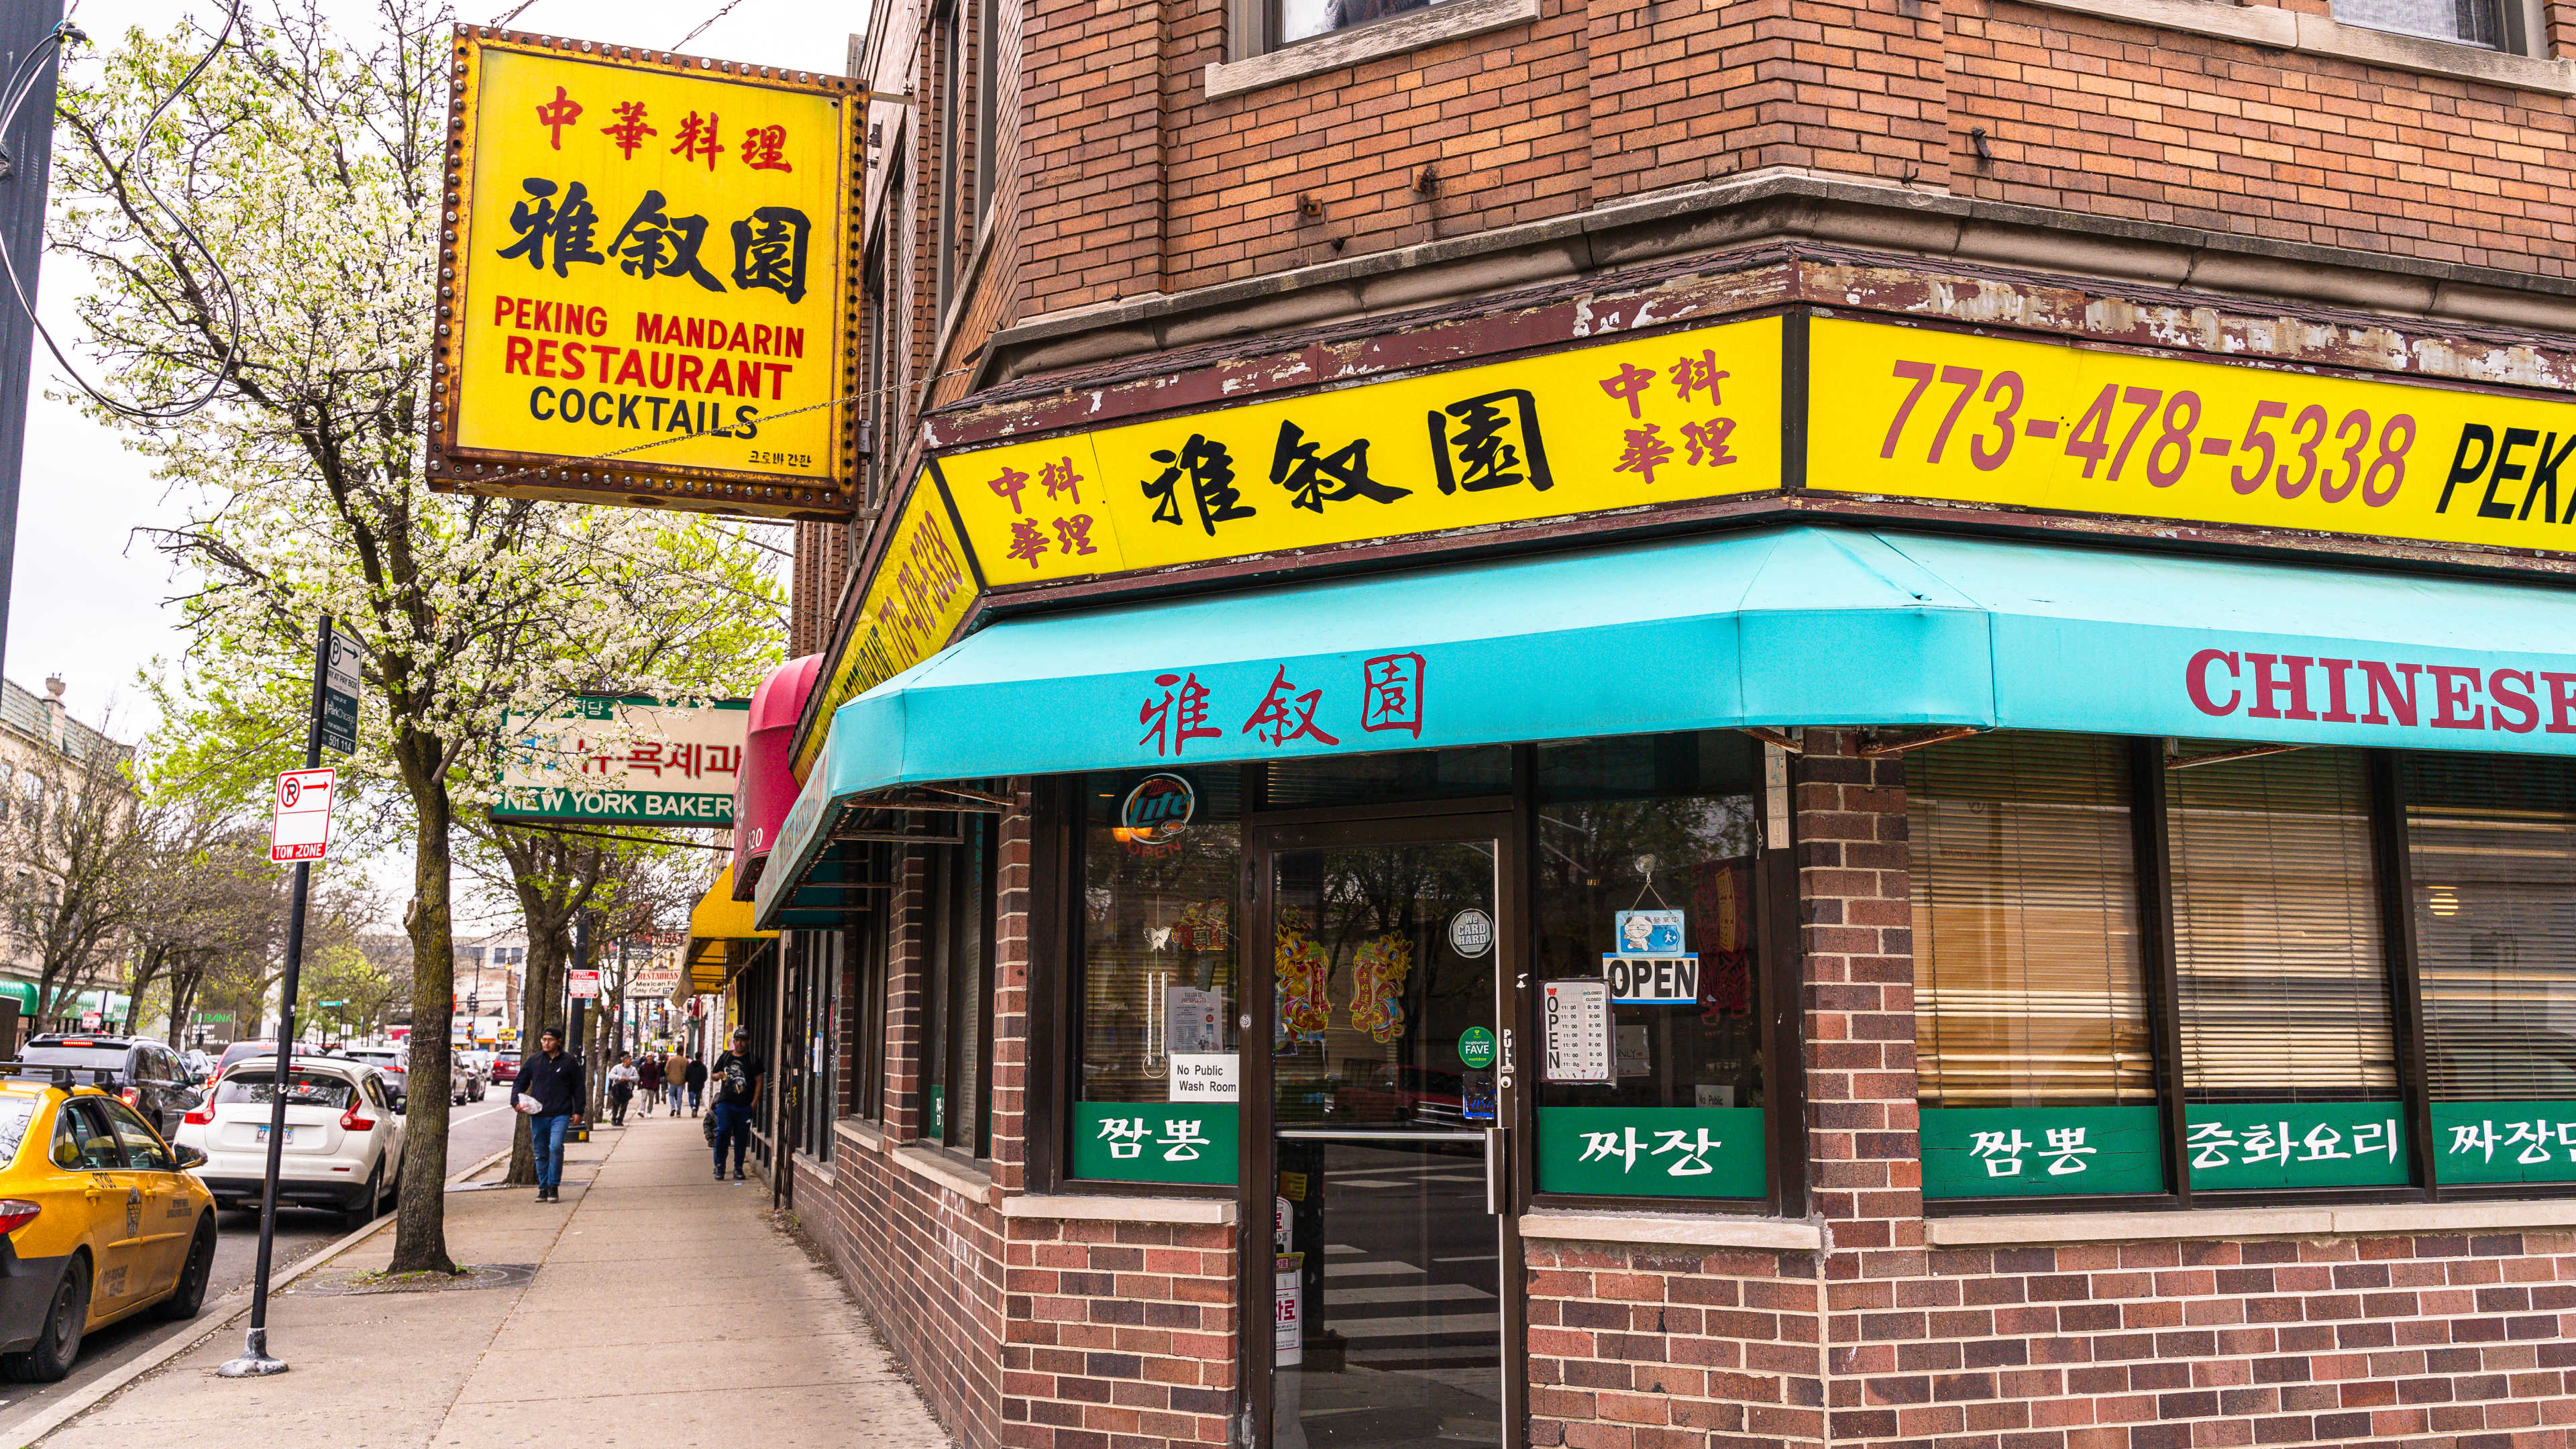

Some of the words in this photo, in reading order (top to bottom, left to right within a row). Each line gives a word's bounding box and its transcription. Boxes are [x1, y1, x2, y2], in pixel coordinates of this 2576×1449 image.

[536, 86, 792, 173] 中華料理
[494, 296, 607, 337] PEKING
[636, 312, 804, 358] MANDARIN
[505, 337, 792, 400] RESTAURANT
[529, 386, 759, 439] COCKTAILS
[1880, 360, 2416, 508] 773-478-5338
[749, 450, 784, 465] 크로바
[788, 453, 812, 468] 간판
[2186, 649, 2576, 733] CHINESE
[572, 792, 639, 814] YORK
[1127, 792, 1192, 828] Lite
[275, 845, 294, 859] TOW
[296, 843, 323, 857] ZONE
[1128, 839, 1181, 859] OPEN
[1458, 924, 1486, 936] CARD
[1465, 914, 1479, 924] We
[1458, 934, 1487, 945] HARD
[1608, 959, 1696, 998] OPEN
[1465, 1045, 1489, 1054] FAVE
[1177, 1065, 1189, 1075] No
[1195, 1065, 1223, 1076] Public
[1179, 1081, 1204, 1091] Wash
[1210, 1081, 1236, 1092] Room
[1097, 1117, 1210, 1162] 짬뽕
[1578, 1127, 1722, 1177] 짜장
[1969, 1127, 2097, 1177] 짬뽕
[2187, 1118, 2397, 1169] 중화요리
